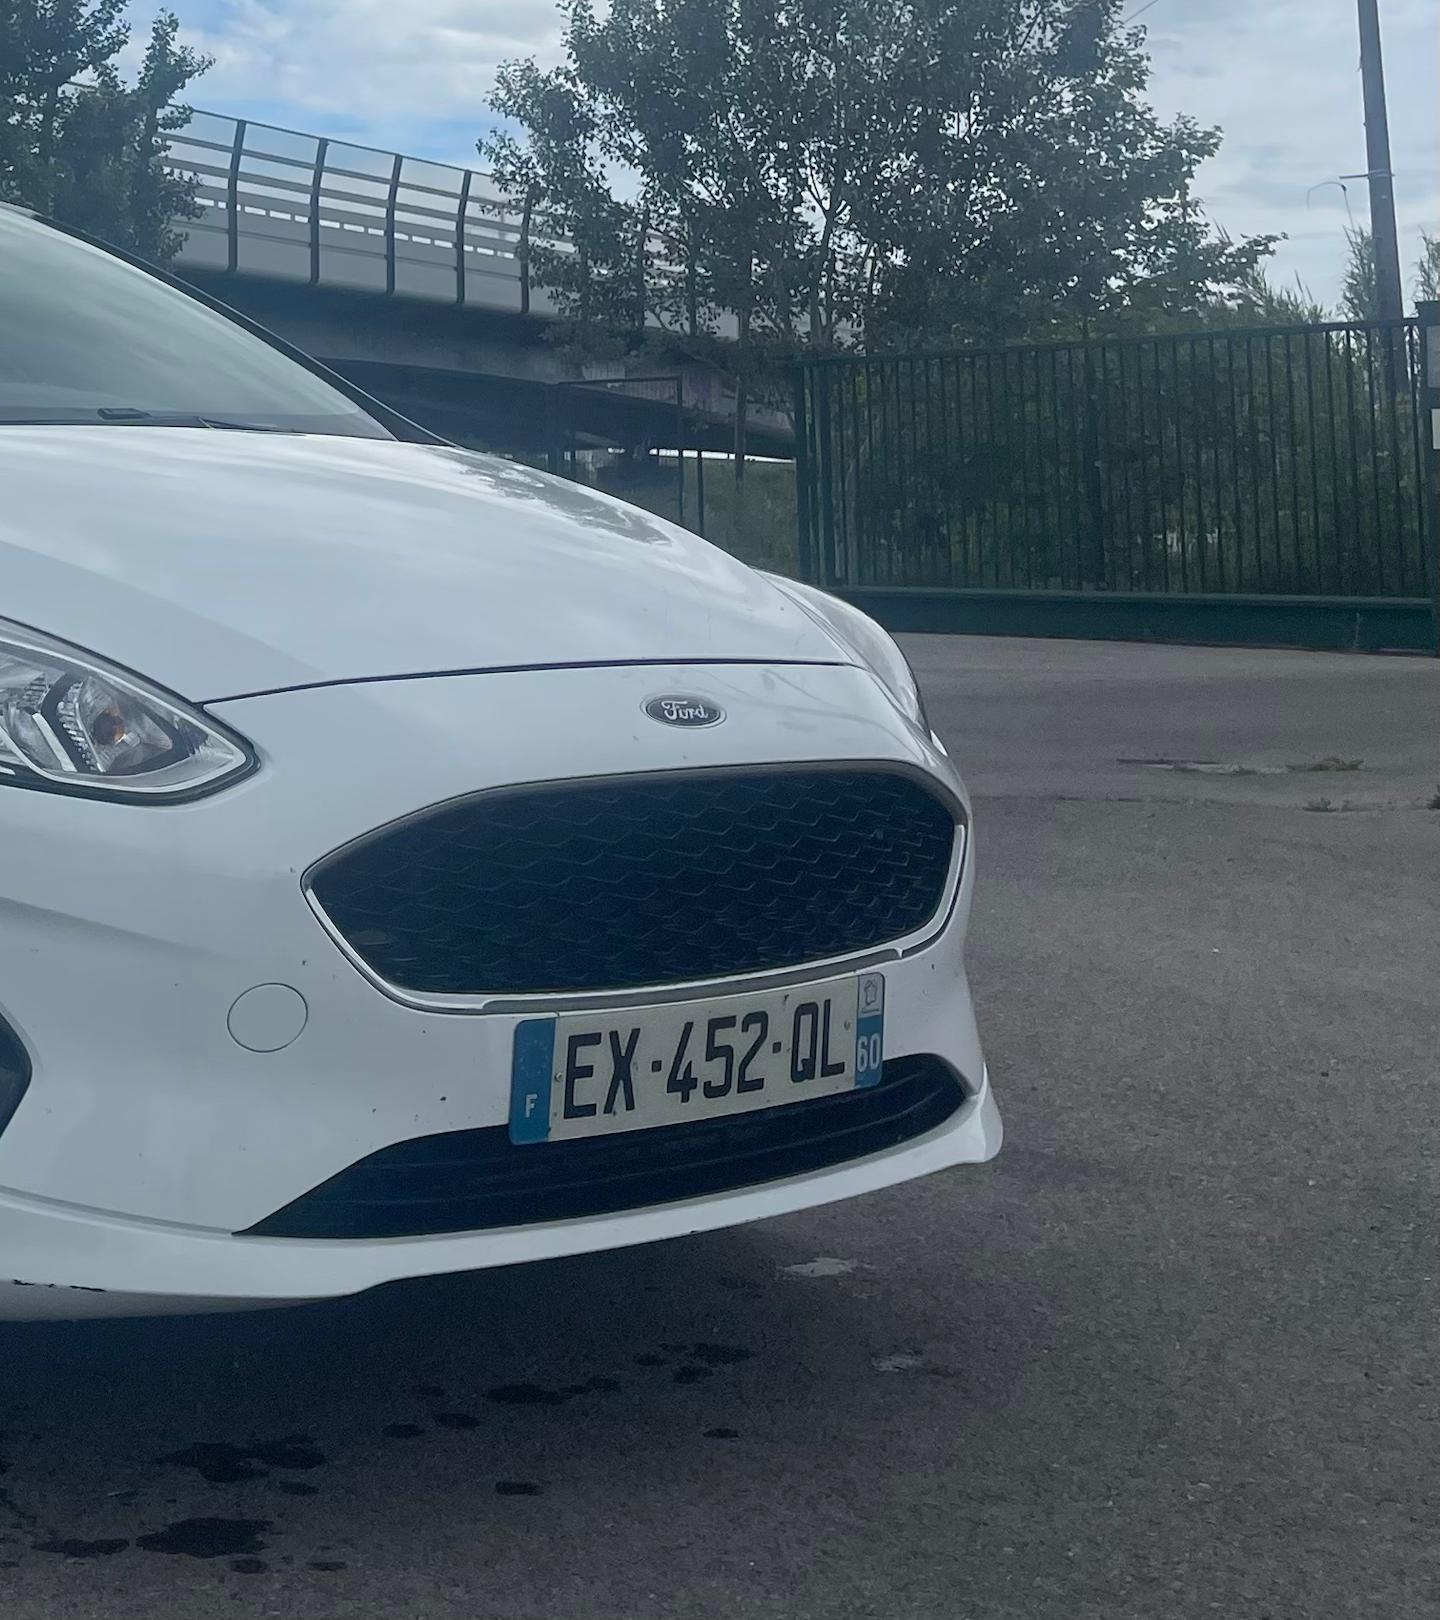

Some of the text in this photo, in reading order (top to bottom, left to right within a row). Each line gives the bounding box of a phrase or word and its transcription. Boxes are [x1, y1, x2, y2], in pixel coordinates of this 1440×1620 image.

[661, 701, 709, 720] Ford
[857, 1033, 881, 1073] 60
[525, 1093, 538, 1119] F
